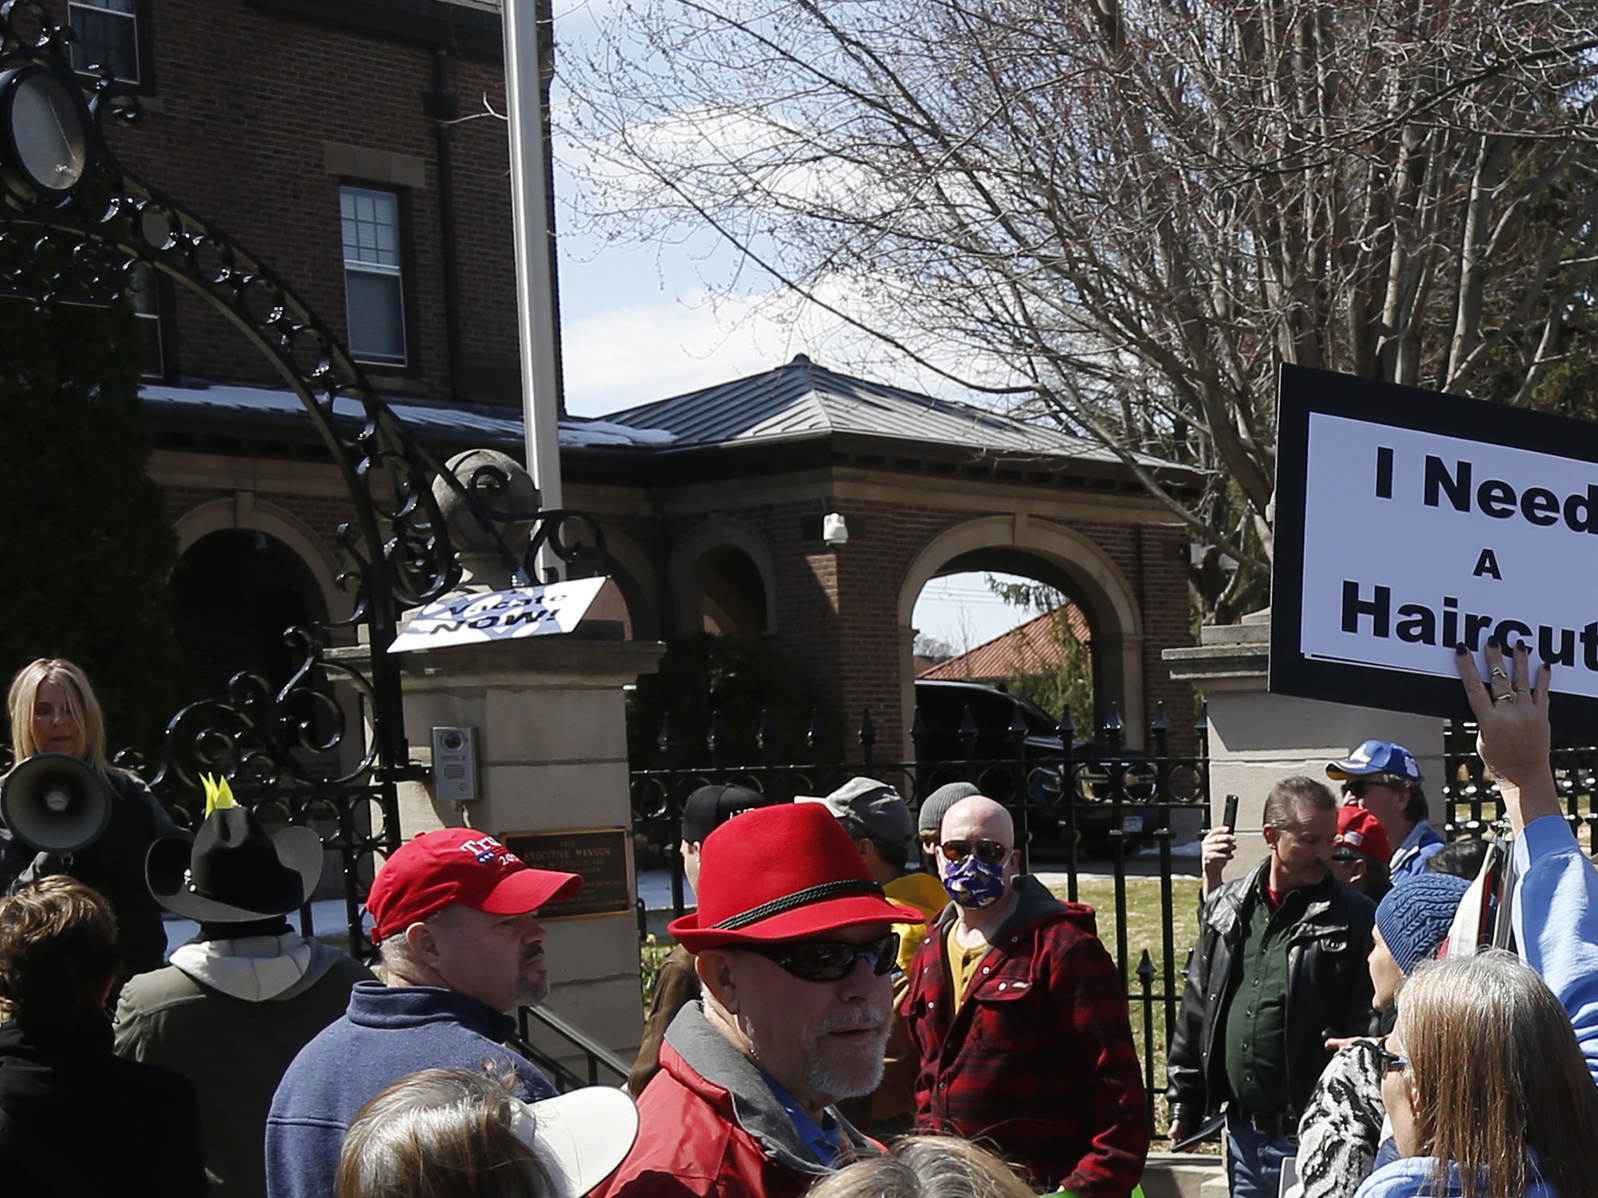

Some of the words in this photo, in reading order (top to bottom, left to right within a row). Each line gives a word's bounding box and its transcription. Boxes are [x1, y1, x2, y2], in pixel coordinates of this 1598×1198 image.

[1376, 446, 1394, 499] I
[1472, 547, 1503, 580] A
[429, 608, 561, 636] NOW!
